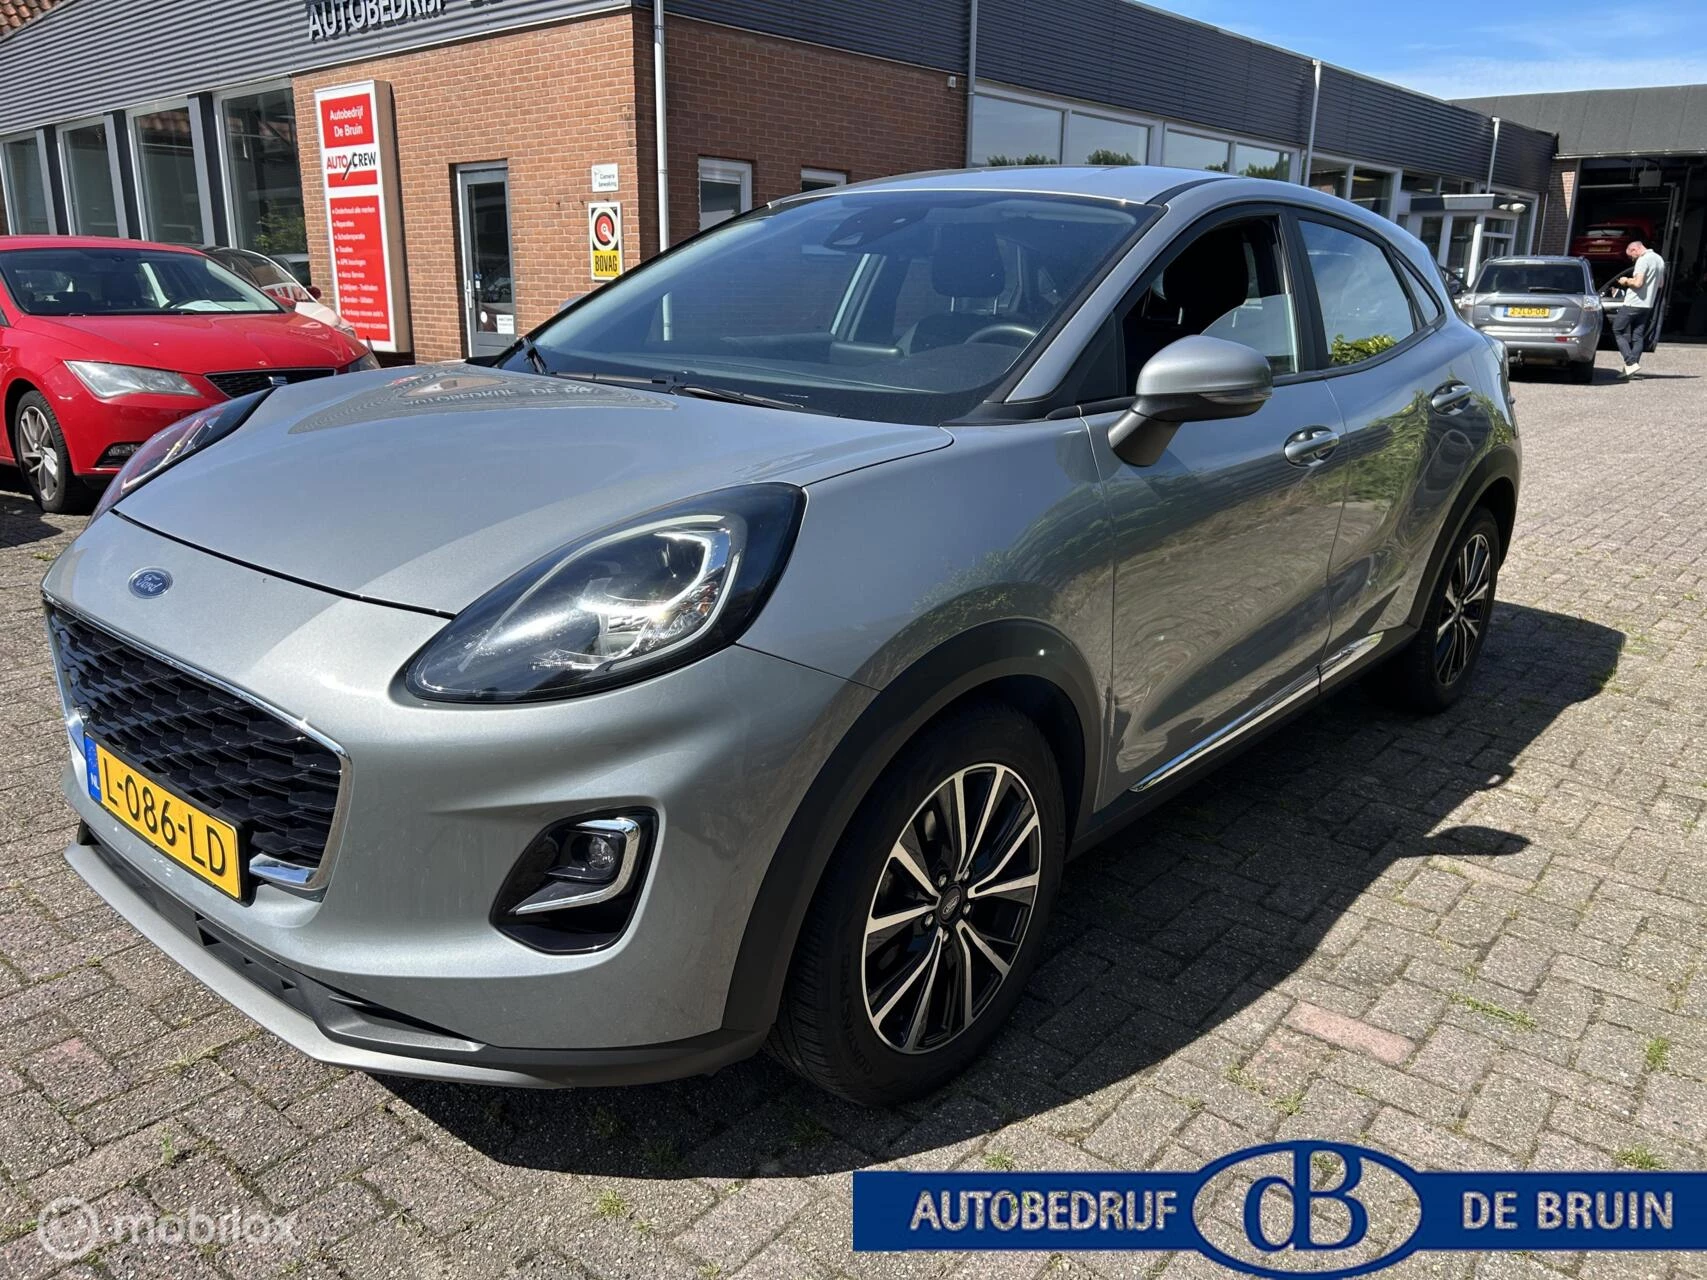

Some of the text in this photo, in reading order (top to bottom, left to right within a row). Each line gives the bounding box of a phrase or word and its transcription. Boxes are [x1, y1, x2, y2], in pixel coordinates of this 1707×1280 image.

[308, 0, 441, 39] AUTOBEDR
[329, 105, 364, 120] Autobedrijf
[333, 123, 363, 137] De Bruin
[595, 255, 618, 272] BOVAG
[90, 772, 100, 791] NL
[103, 757, 226, 877] L-086-LD
